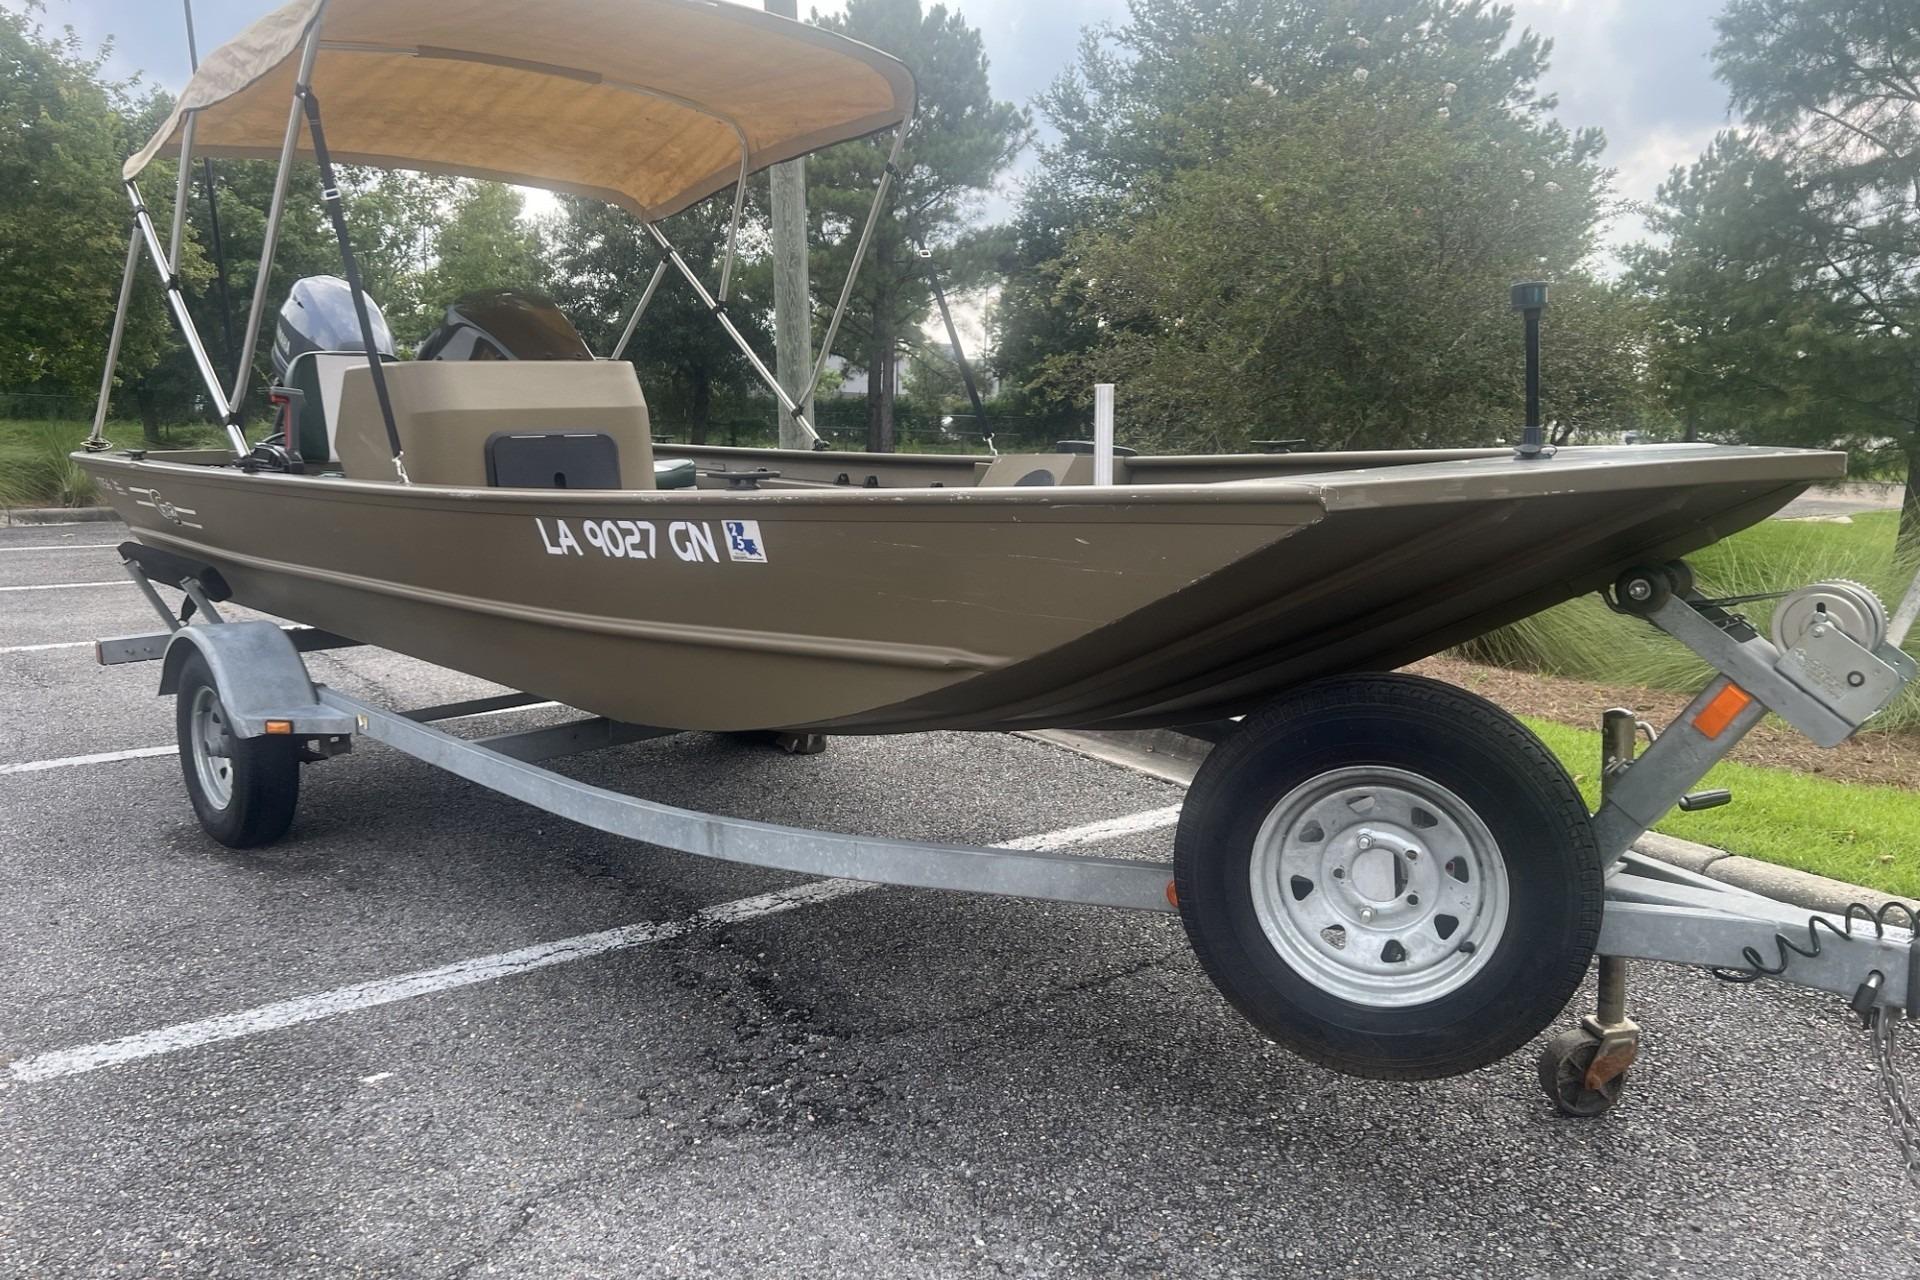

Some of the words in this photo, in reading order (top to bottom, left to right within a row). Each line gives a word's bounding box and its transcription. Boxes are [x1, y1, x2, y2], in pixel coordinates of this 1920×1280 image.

[535, 518, 583, 556] LA
[584, 520, 656, 559] 9027
[668, 521, 720, 563] GN
